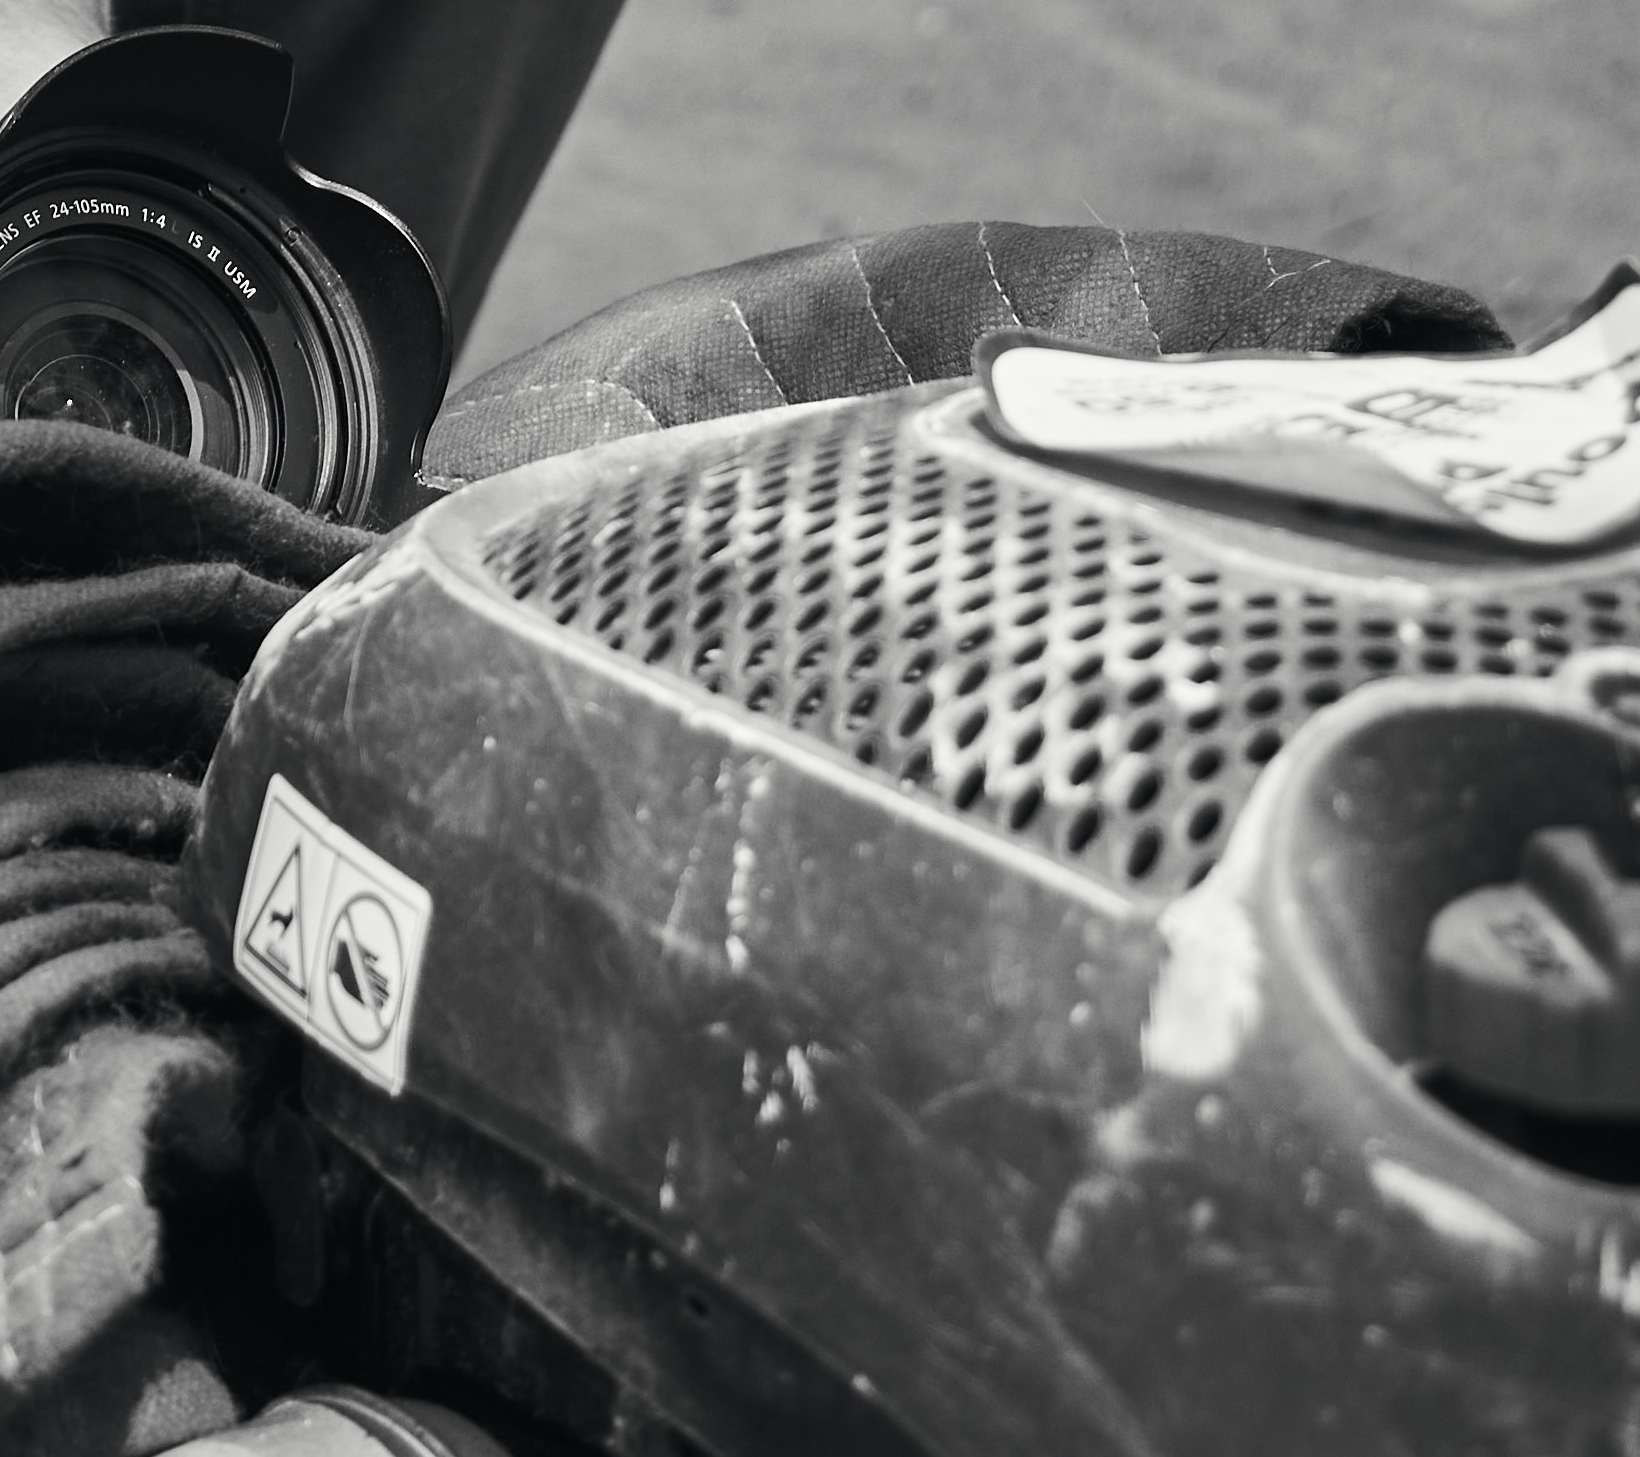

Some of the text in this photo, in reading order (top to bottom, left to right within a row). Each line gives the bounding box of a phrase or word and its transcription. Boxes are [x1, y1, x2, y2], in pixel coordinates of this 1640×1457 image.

[23, 209, 41, 229] EF
[49, 198, 130, 218] 24-105mm
[141, 208, 166, 229] 1:4
[188, 230, 203, 249] IS
[223, 260, 257, 299] USM
